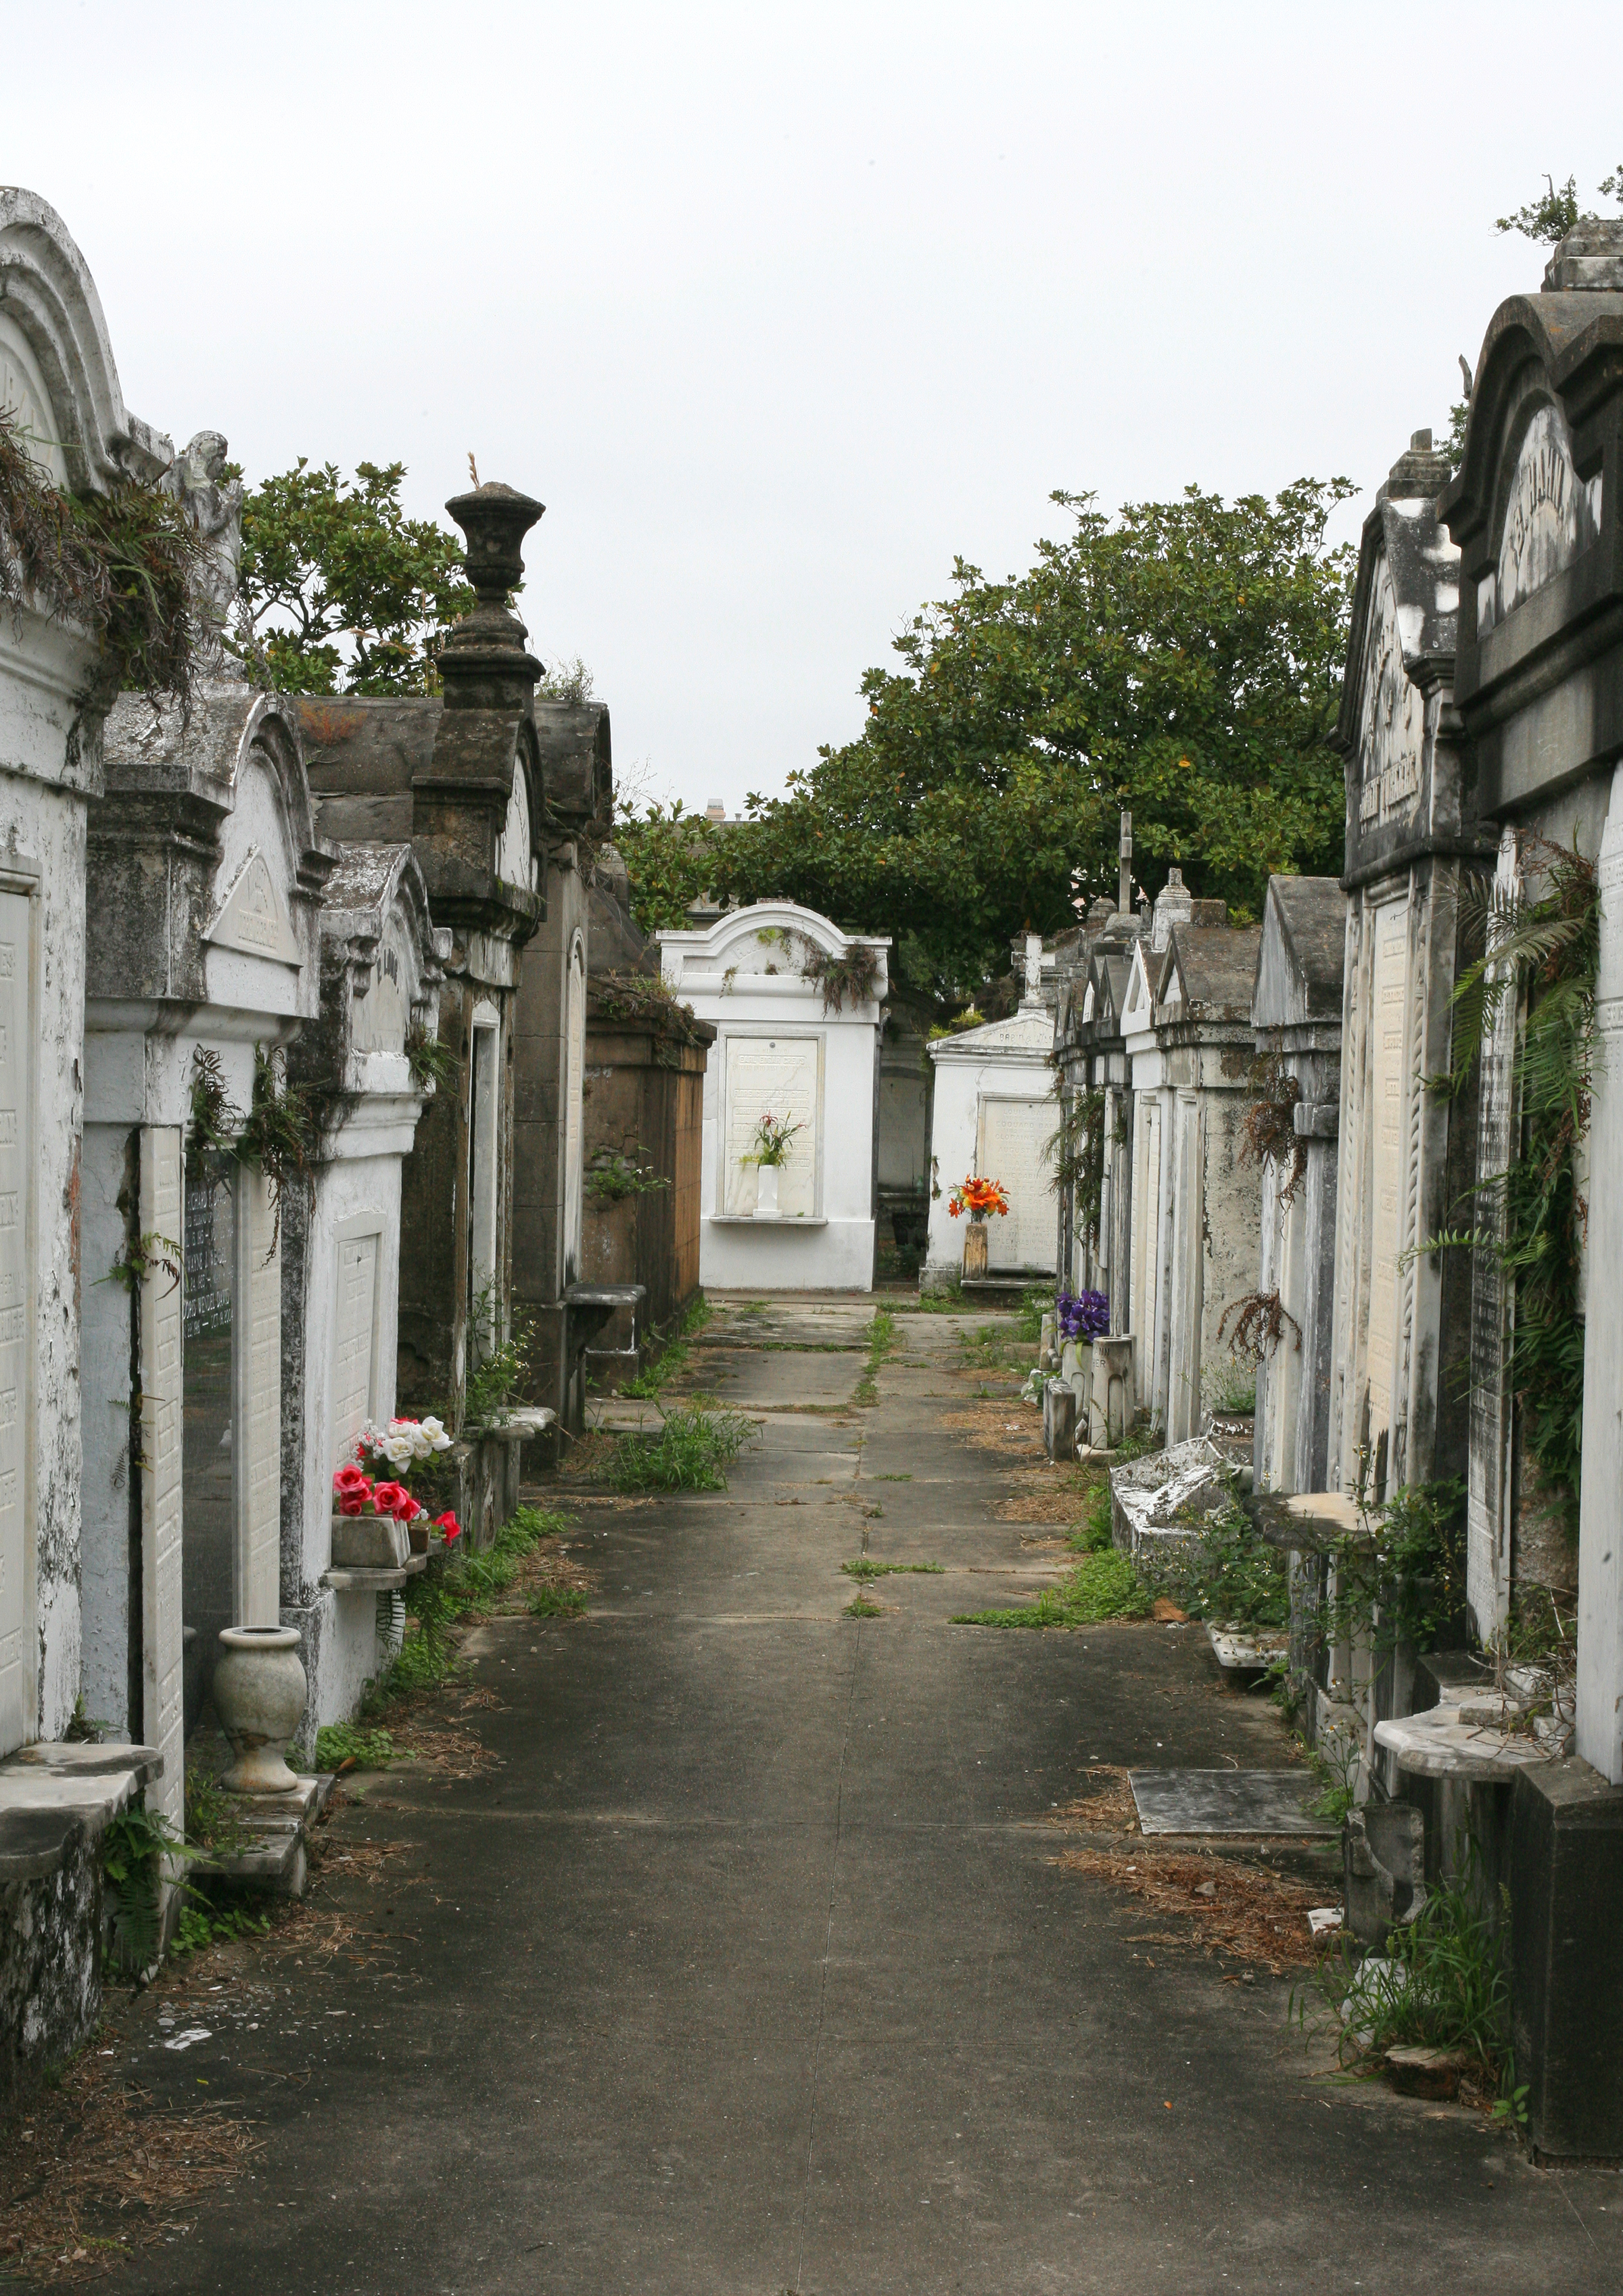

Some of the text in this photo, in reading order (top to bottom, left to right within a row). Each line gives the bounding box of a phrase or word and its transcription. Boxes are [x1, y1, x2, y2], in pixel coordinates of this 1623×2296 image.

[740, 1056, 757, 1064] EARL
[760, 1056, 781, 1064] EDGAR
[734, 1090, 763, 1098] FLORENCE
[786, 1159, 810, 1168] ESTON
